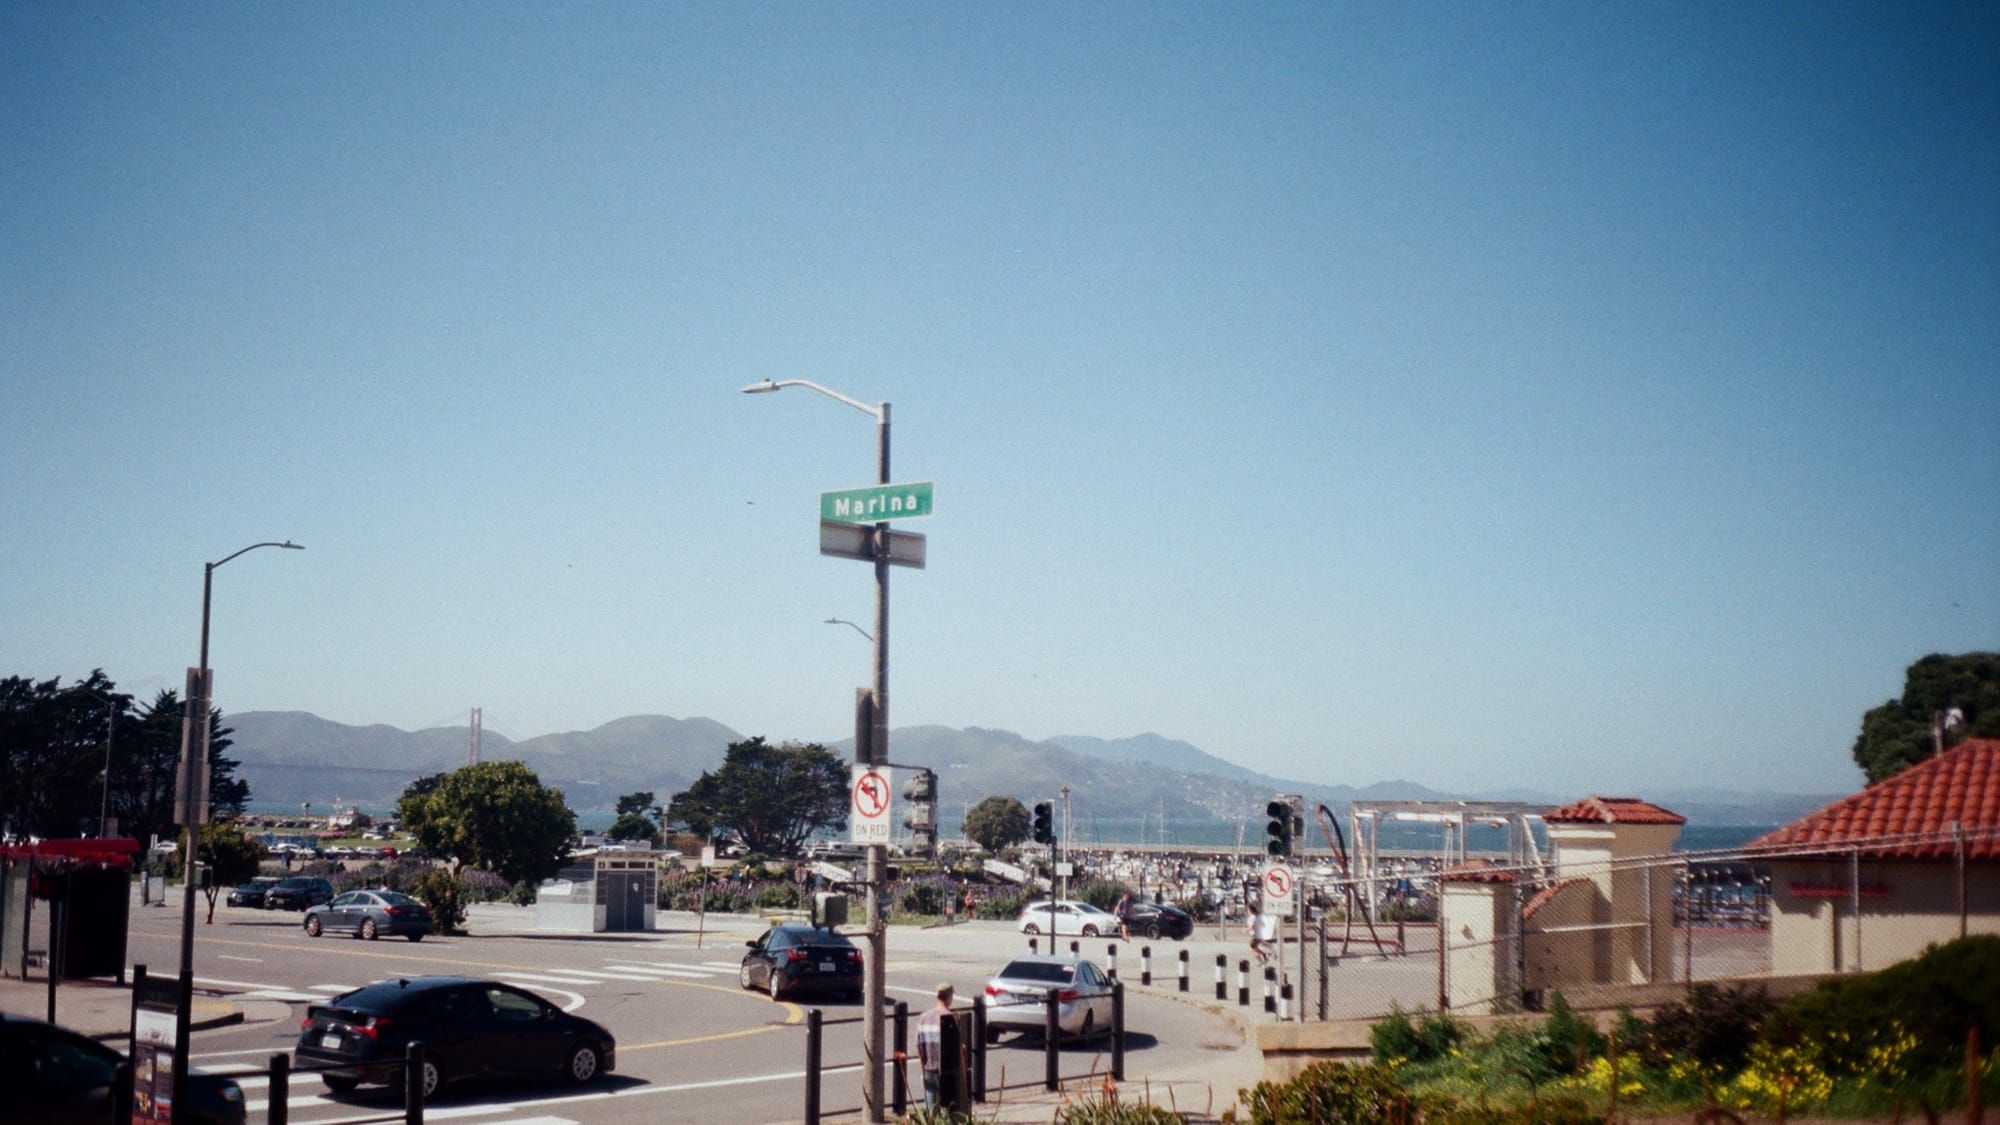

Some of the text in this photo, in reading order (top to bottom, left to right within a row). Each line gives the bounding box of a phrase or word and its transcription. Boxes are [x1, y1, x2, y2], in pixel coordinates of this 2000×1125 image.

[835, 494, 917, 517] Marina
[855, 823, 887, 836] ON RED
